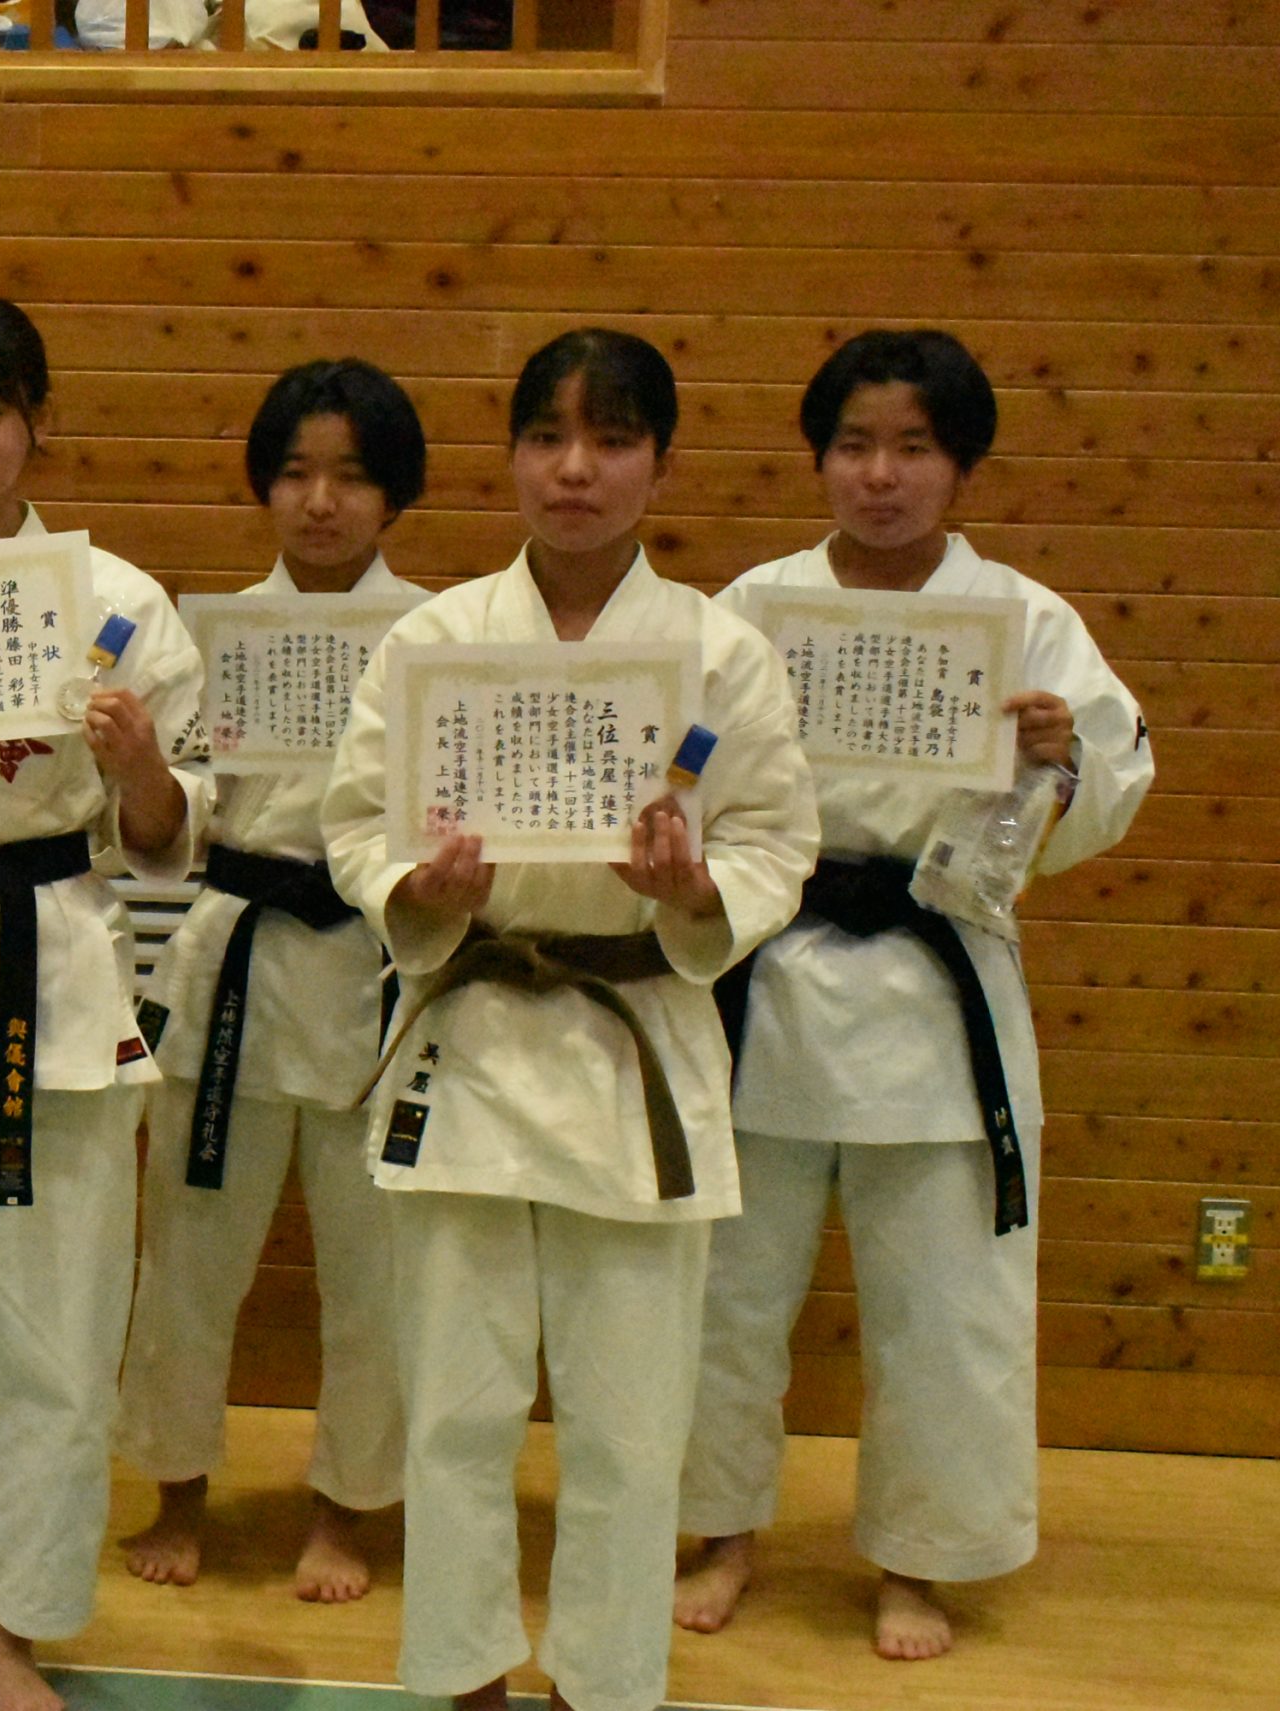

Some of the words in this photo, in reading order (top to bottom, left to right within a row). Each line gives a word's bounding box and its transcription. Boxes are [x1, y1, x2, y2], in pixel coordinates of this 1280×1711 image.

[1, 580, 23, 634] 準優勝
[40, 610, 62, 663] 賞状
[962, 668, 985, 718] 賞状
[597, 701, 619, 745] 三位
[453, 700, 468, 822] 上地流空手道連合会
[582, 699, 595, 831] あなたは上地流空手道
